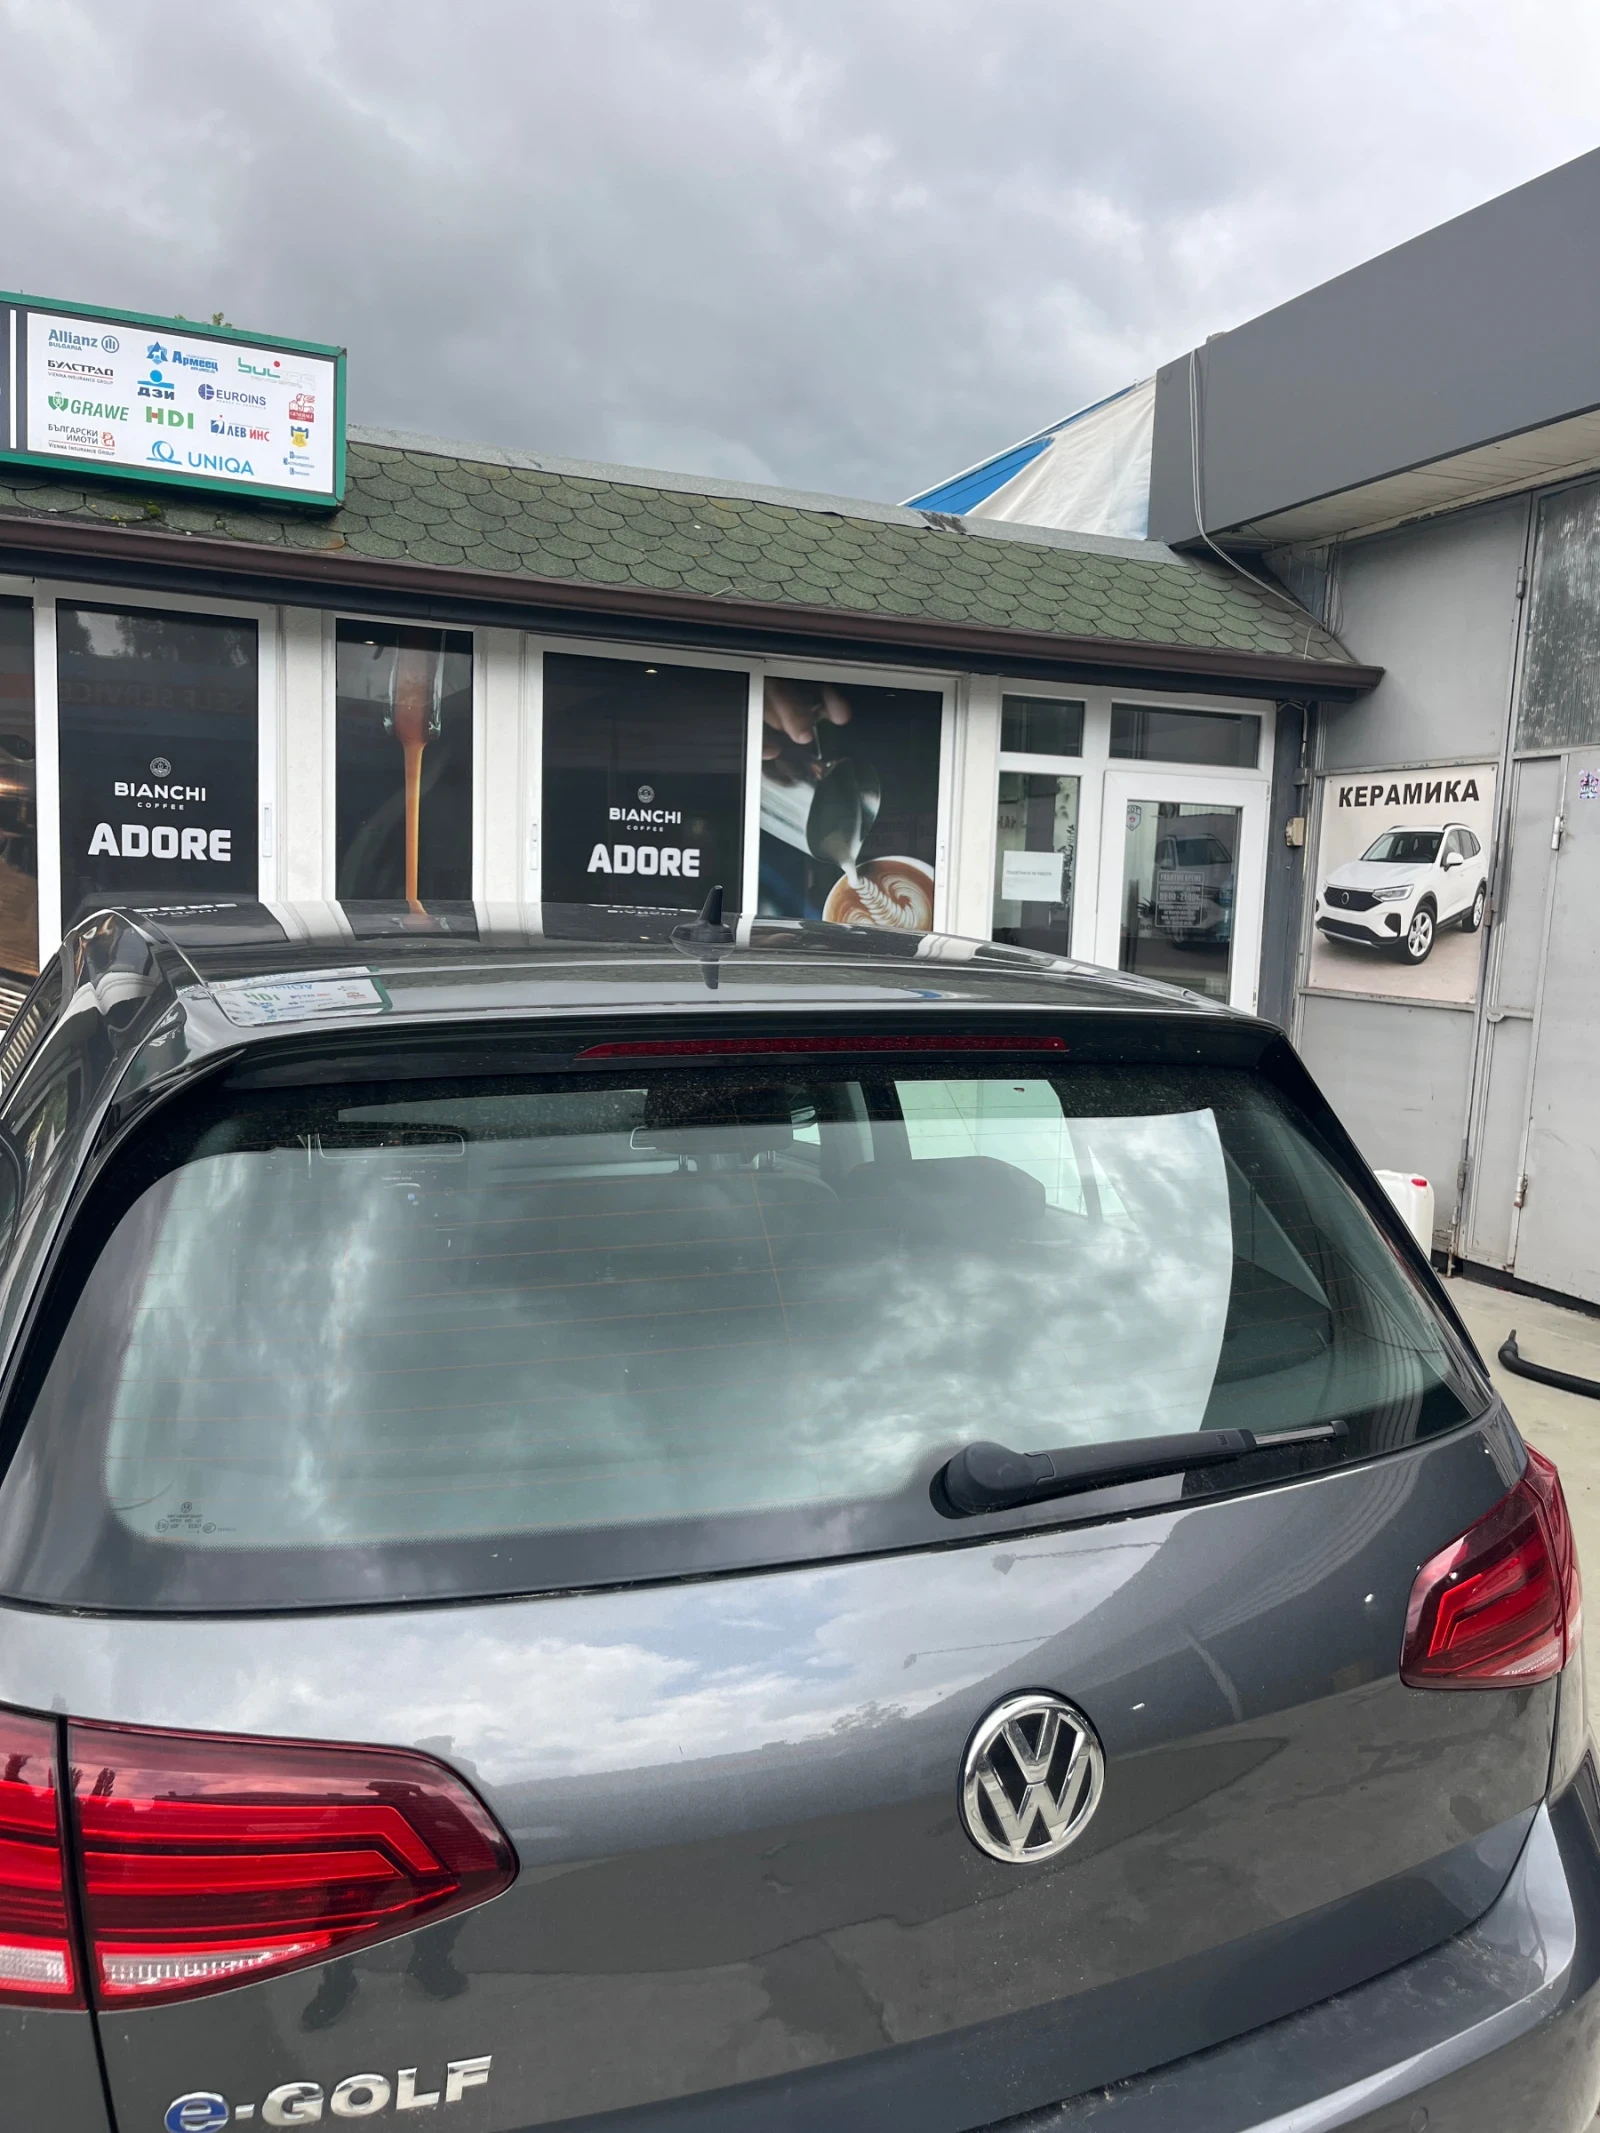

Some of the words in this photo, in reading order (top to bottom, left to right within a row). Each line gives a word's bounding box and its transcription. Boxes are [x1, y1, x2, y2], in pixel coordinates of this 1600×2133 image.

[48, 329, 98, 348] Allianz
[48, 341, 82, 351] BULGARIA
[48, 360, 113, 376] БУЛСТРАД
[172, 351, 218, 371] Армеец
[137, 386, 175, 401] ДЗИ
[216, 389, 266, 407] EUROINS
[70, 399, 129, 421] GRAWE
[146, 406, 194, 430] HDI
[48, 424, 98, 438] БЪЛГАРСКИ
[66, 434, 98, 444] ИМОТИ
[227, 426, 247, 438] ЛЕВ
[249, 428, 270, 441] ИНС
[188, 451, 254, 476] UNIQA
[114, 781, 206, 801] BIANCHI
[1338, 778, 1480, 808] КЕРАМИКА
[137, 801, 184, 811] COFFEE
[609, 807, 681, 824] BIANCHI
[626, 824, 664, 832] COFFEE
[88, 822, 231, 862] ADORE
[587, 843, 700, 877] ADORE
[163, 2055, 493, 2133] e-GOLF
